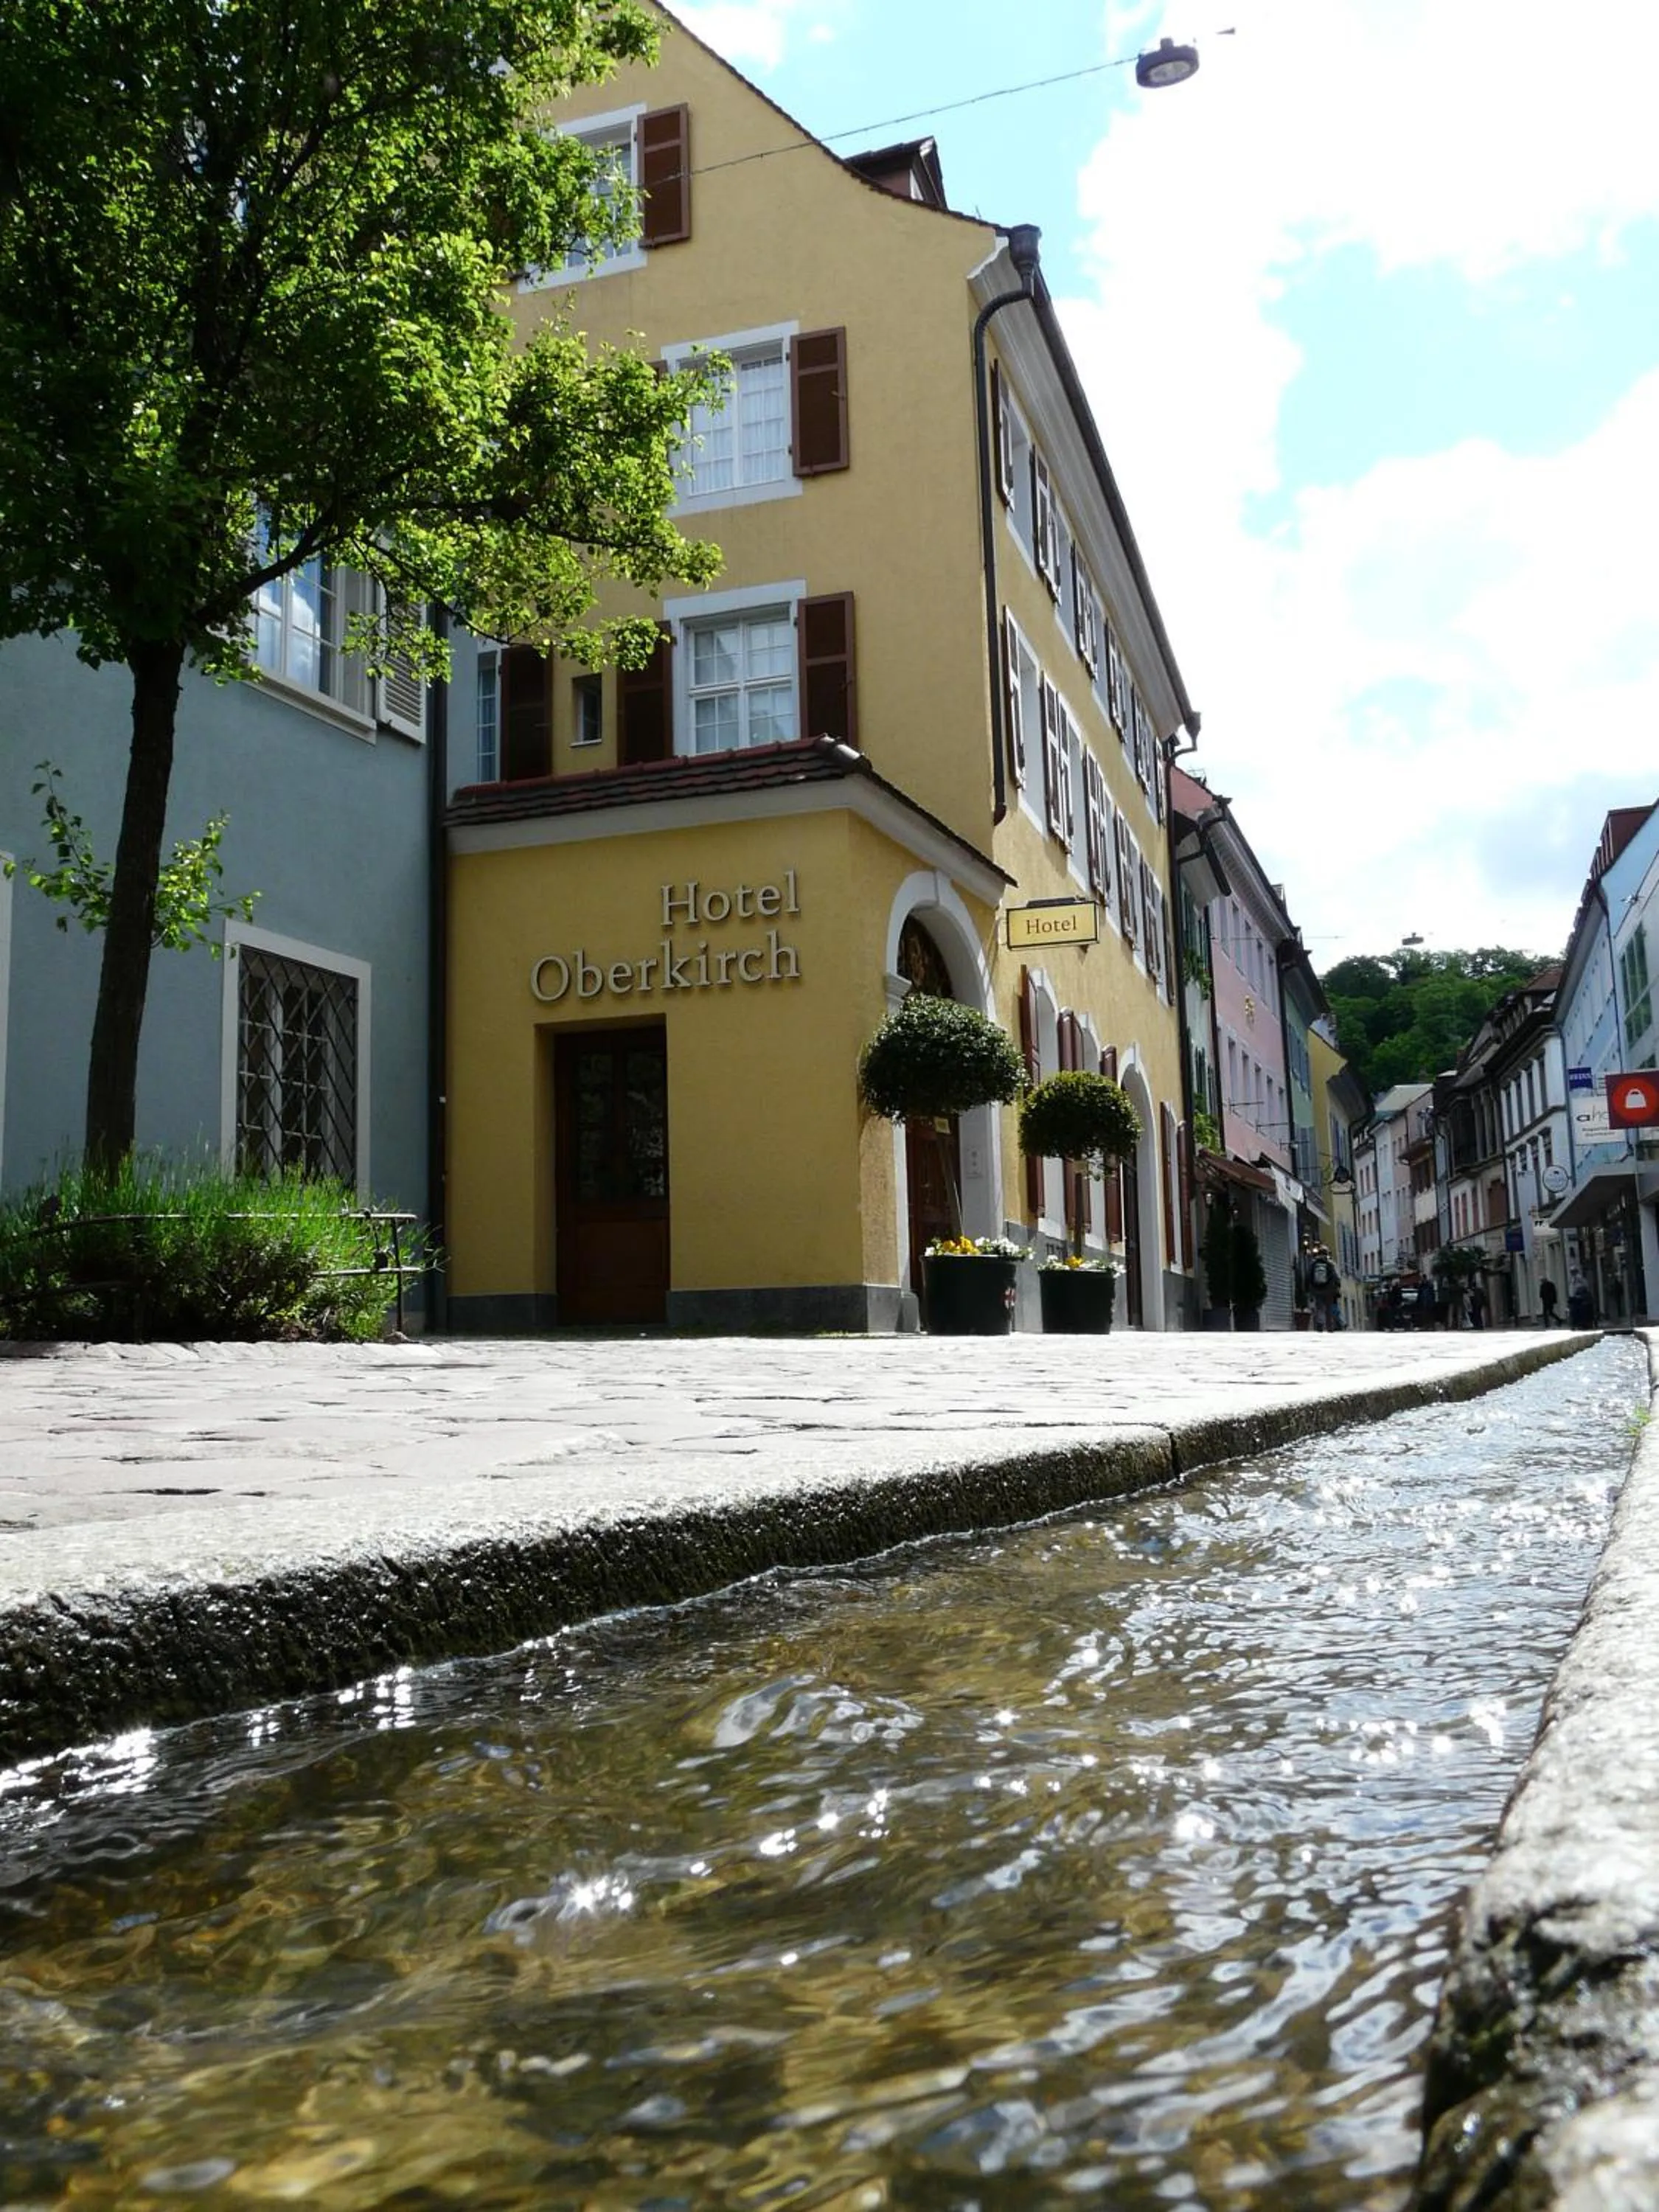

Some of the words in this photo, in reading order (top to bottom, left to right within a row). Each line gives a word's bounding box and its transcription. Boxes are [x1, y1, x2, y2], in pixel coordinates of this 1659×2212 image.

[661, 869, 801, 926] Hotel
[1026, 914, 1077, 935] Hotel
[530, 930, 801, 1002] Oberkirch
